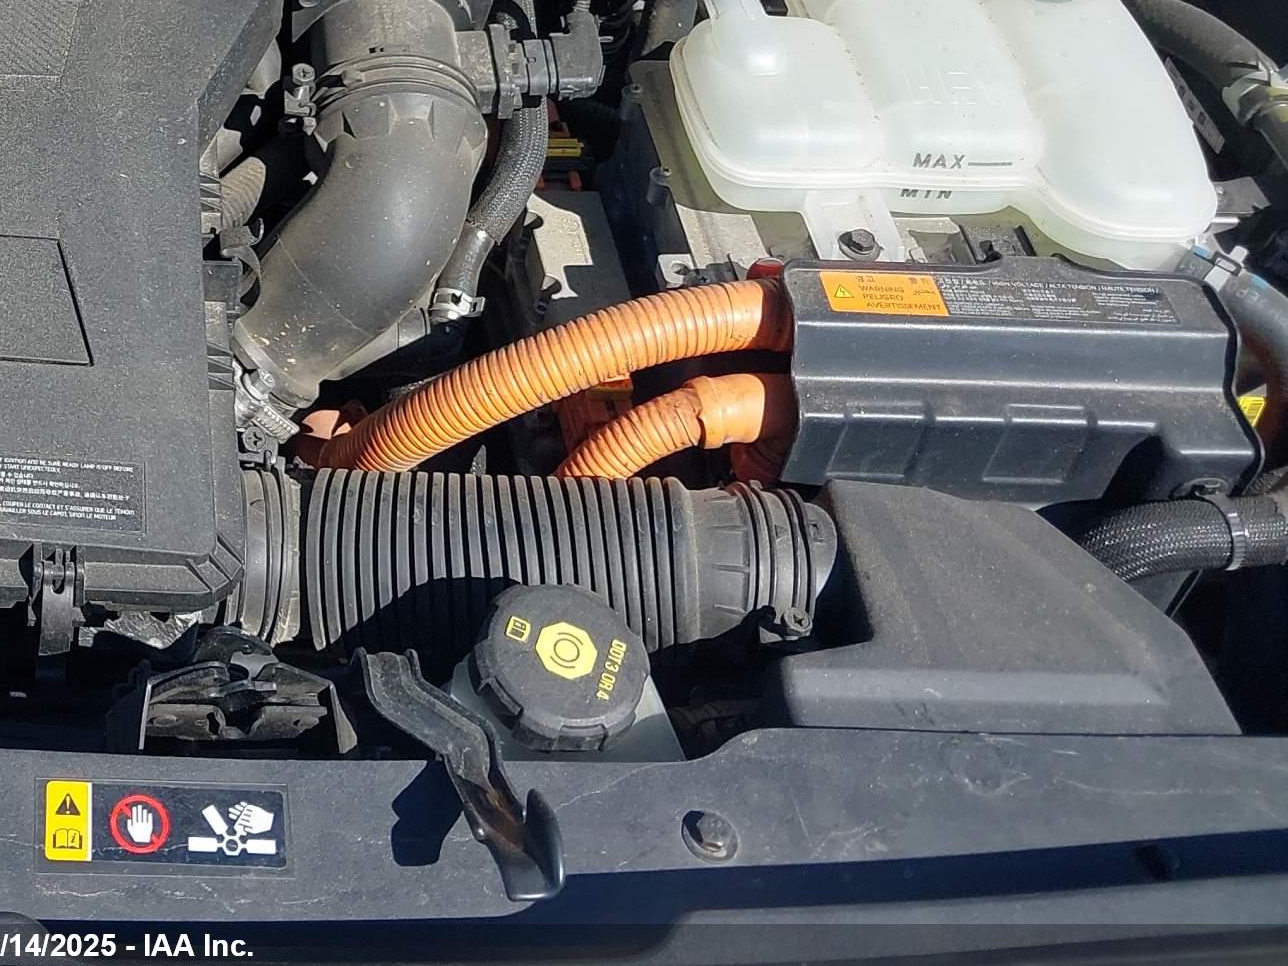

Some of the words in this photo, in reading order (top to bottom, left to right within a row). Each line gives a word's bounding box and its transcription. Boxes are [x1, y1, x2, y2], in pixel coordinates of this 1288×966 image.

[912, 152, 965, 169] MAX
[858, 285, 905, 294] WARNING
[598, 672, 616, 691] OR
